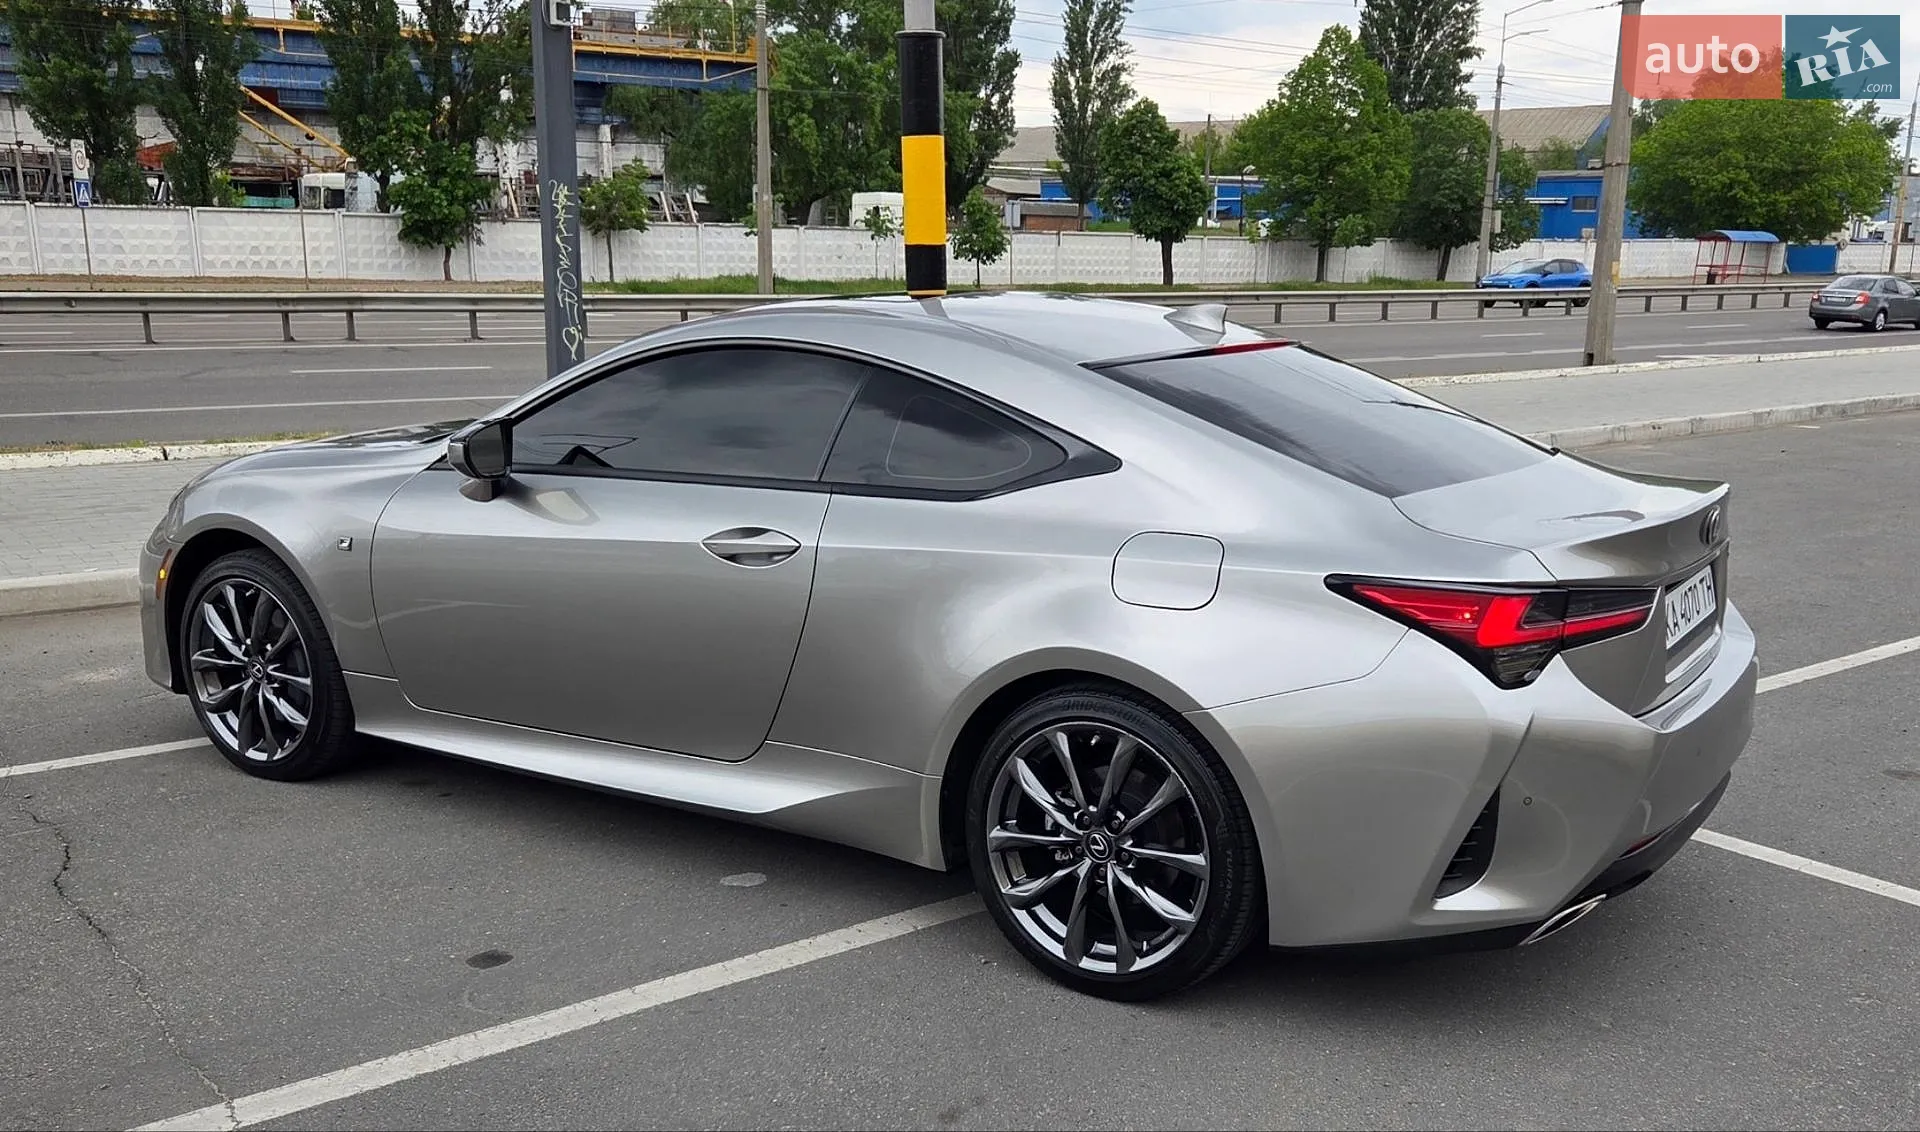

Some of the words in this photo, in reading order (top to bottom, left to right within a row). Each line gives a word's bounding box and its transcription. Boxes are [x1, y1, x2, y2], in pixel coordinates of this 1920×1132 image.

[1665, 600, 1681, 642] KA
[1680, 583, 1701, 626] 4070
[1699, 572, 1714, 609] TH
